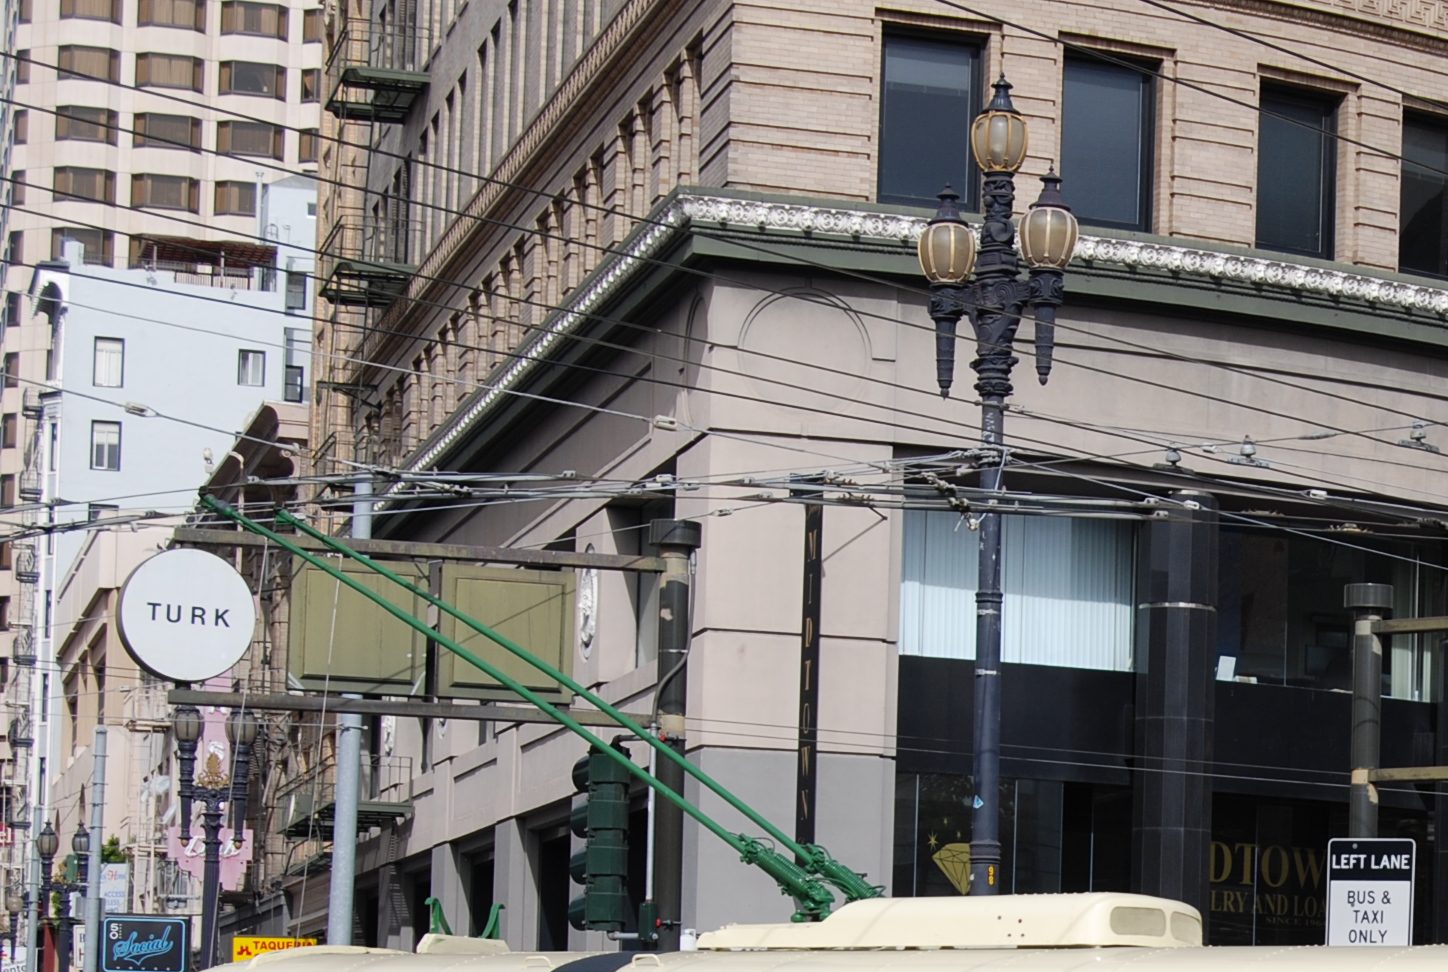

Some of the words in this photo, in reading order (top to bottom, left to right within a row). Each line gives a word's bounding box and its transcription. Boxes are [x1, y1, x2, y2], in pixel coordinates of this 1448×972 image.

[147, 602, 230, 627] TURK
[1209, 841, 1326, 890] DTOW
[1332, 854, 1367, 869] LEFT
[1371, 854, 1410, 869] LANE
[1210, 890, 1248, 913] LRY
[1252, 893, 1288, 916] AND
[1293, 895, 1326, 918] LOA
[1347, 890, 1375, 904] BUS
[1381, 890, 1391, 905] &
[1353, 910, 1383, 924] TAXI
[113, 925, 173, 961] Social
[1348, 929, 1387, 943] ONLY
